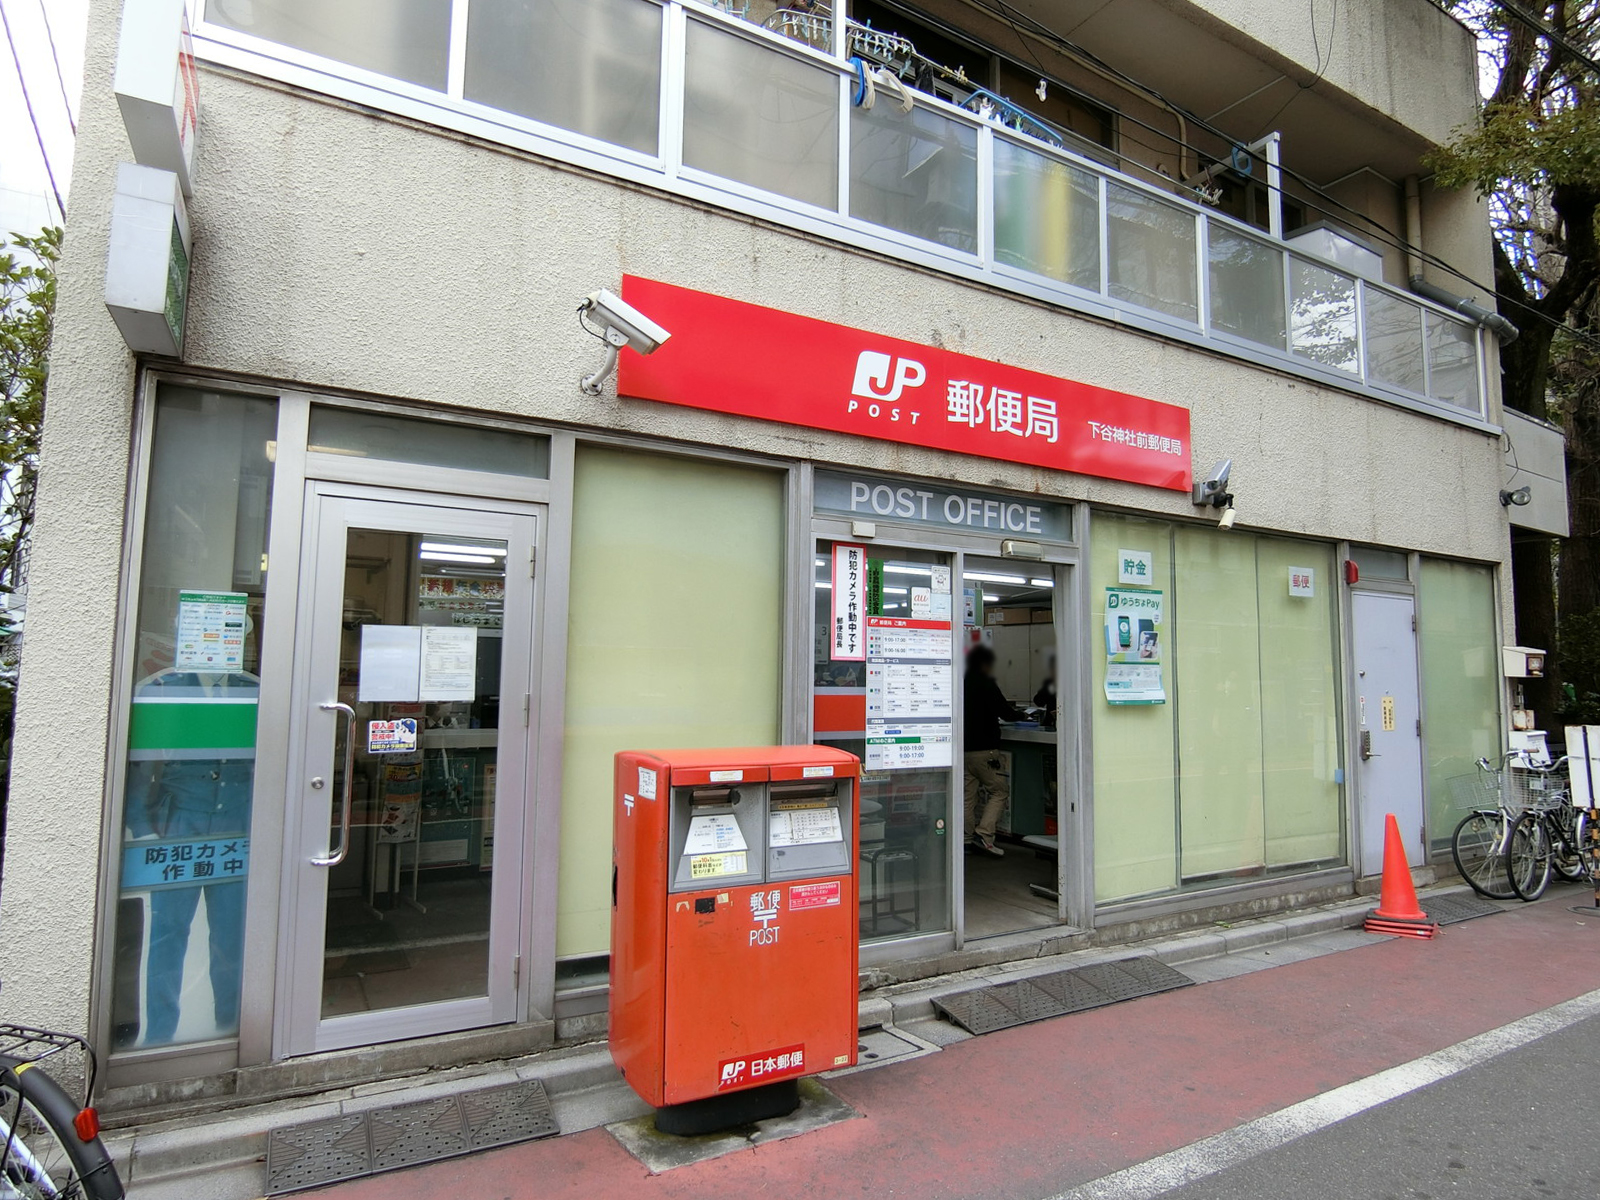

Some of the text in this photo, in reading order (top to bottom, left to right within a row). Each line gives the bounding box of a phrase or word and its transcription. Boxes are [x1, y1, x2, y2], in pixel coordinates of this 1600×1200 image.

[847, 400, 920, 425] POST
[947, 379, 1059, 443] 郵便局
[1087, 420, 1182, 456] 下谷神社前郵便局
[851, 481, 1041, 534] POST OFFICE
[1123, 558, 1147, 576] 貯金
[848, 550, 858, 654] 防犯カメラ作動中です
[914, 594, 928, 603] au
[1120, 597, 1160, 610] ゆうちょPay
[162, 858, 243, 881] 作動中
[750, 889, 780, 912] 郵便
[749, 926, 780, 946] POST
[751, 1051, 803, 1076] 日本郵便
